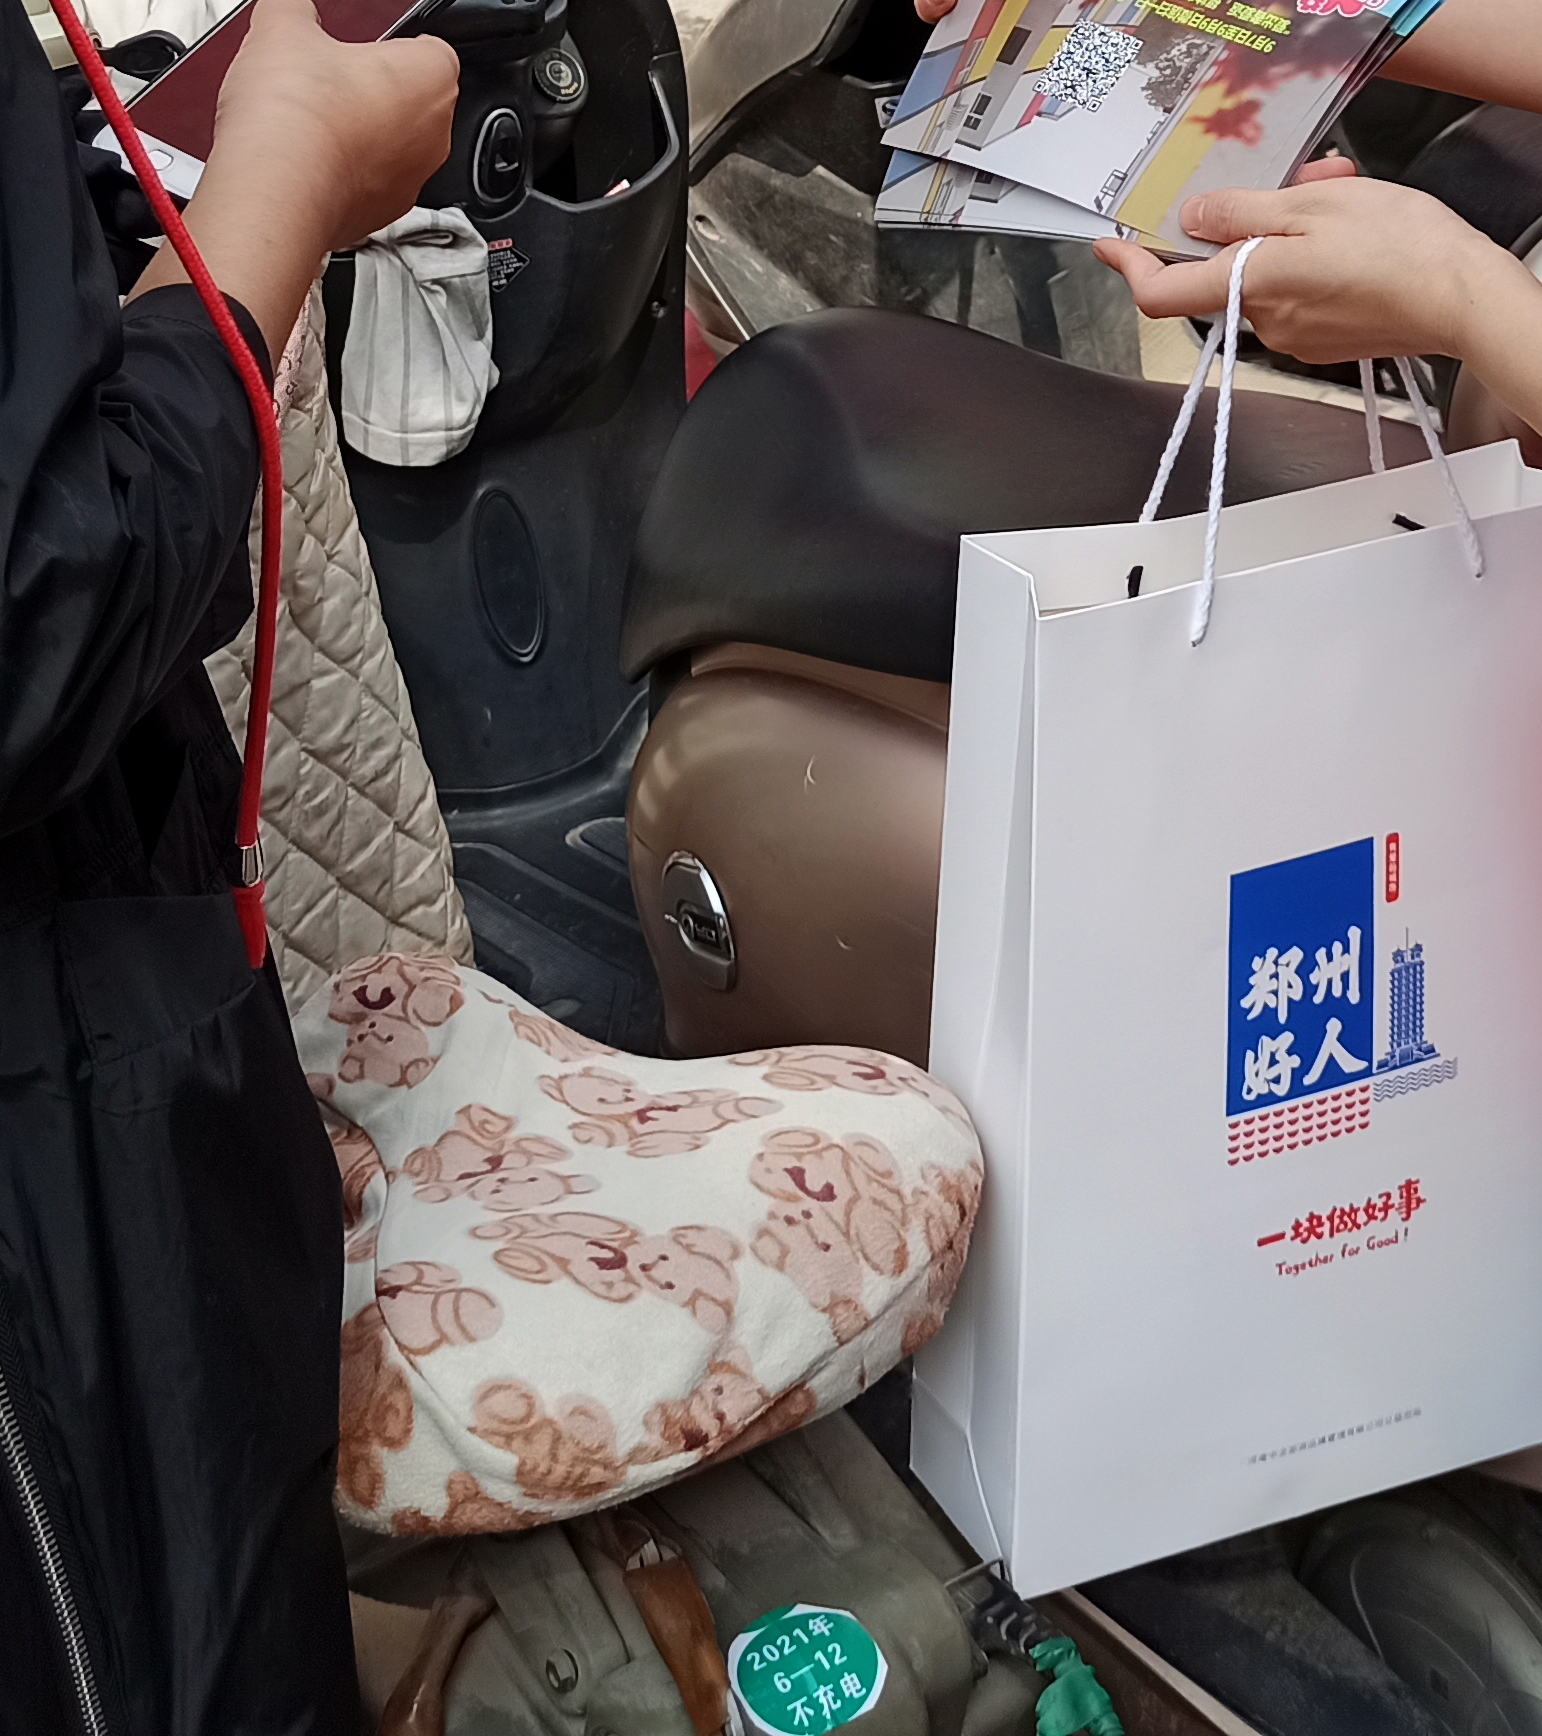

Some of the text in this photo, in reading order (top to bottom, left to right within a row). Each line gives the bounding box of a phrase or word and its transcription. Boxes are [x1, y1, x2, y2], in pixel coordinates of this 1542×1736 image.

[1240, 925, 1362, 1025] 郑州
[1241, 1017, 1369, 1101] 好人
[1257, 1178, 1427, 1247] 一块做好事
[1275, 1251, 1335, 1278] Together
[1341, 1243, 1361, 1260] for
[746, 1614, 835, 1671] 2021年
[786, 1672, 867, 1727] 不充电
